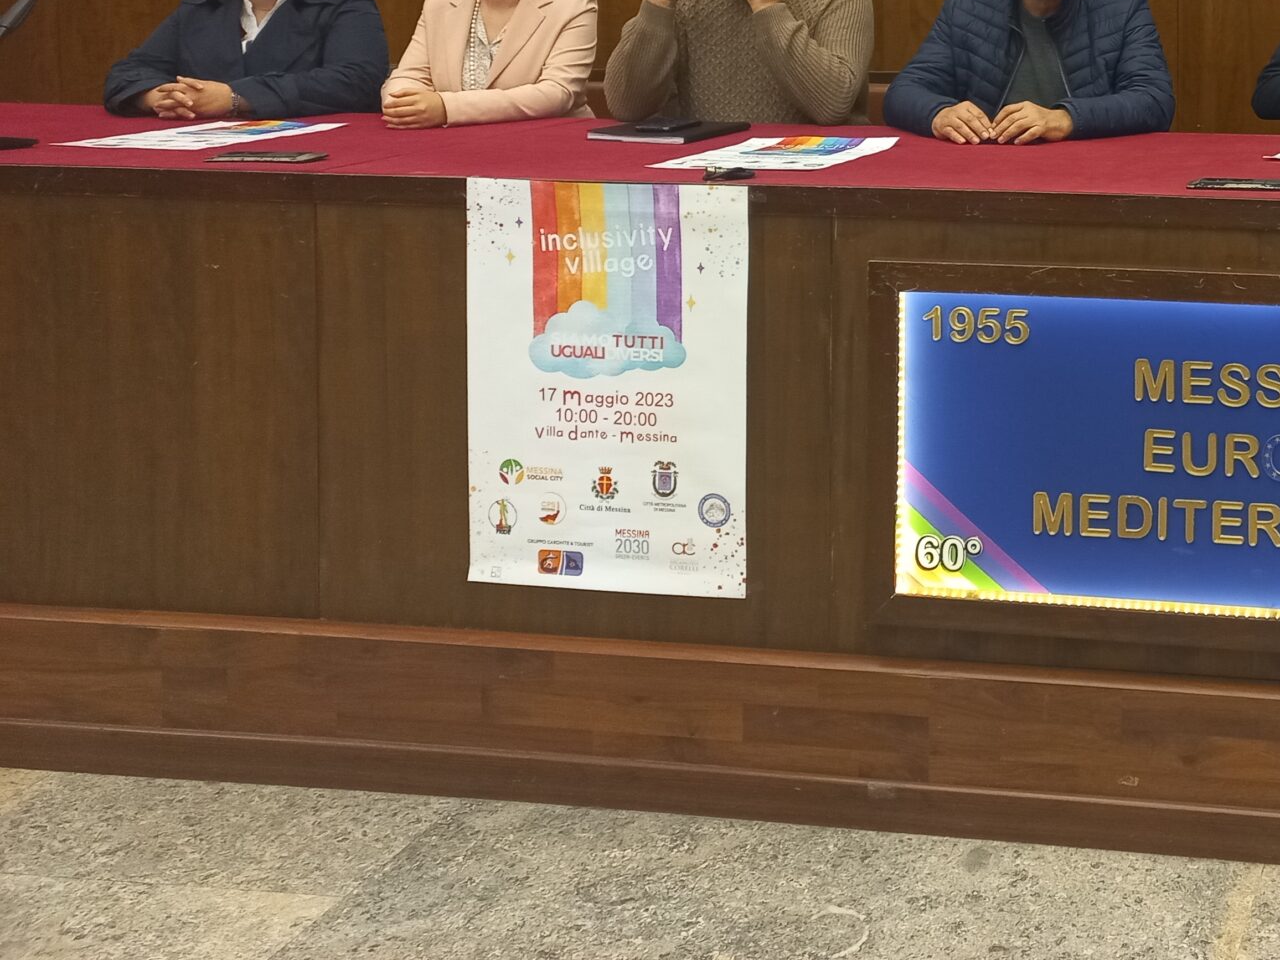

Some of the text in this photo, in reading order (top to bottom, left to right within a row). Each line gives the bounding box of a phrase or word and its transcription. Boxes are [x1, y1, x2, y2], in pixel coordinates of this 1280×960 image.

[539, 224, 673, 251] inclusivity
[565, 250, 653, 277] village
[922, 305, 1030, 345] 1955
[612, 334, 664, 350] TUTTI
[550, 344, 664, 362] UGUALI DIVERSI
[538, 387, 557, 402] 17
[635, 391, 674, 407] 2023
[555, 408, 598, 424] 10:00
[613, 410, 657, 427] 20:00
[526, 466, 563, 476] MESSINA
[597, 504, 603, 512] di
[605, 505, 631, 513] Messina
[615, 528, 650, 538] MESSINA
[615, 538, 650, 554] 2030
